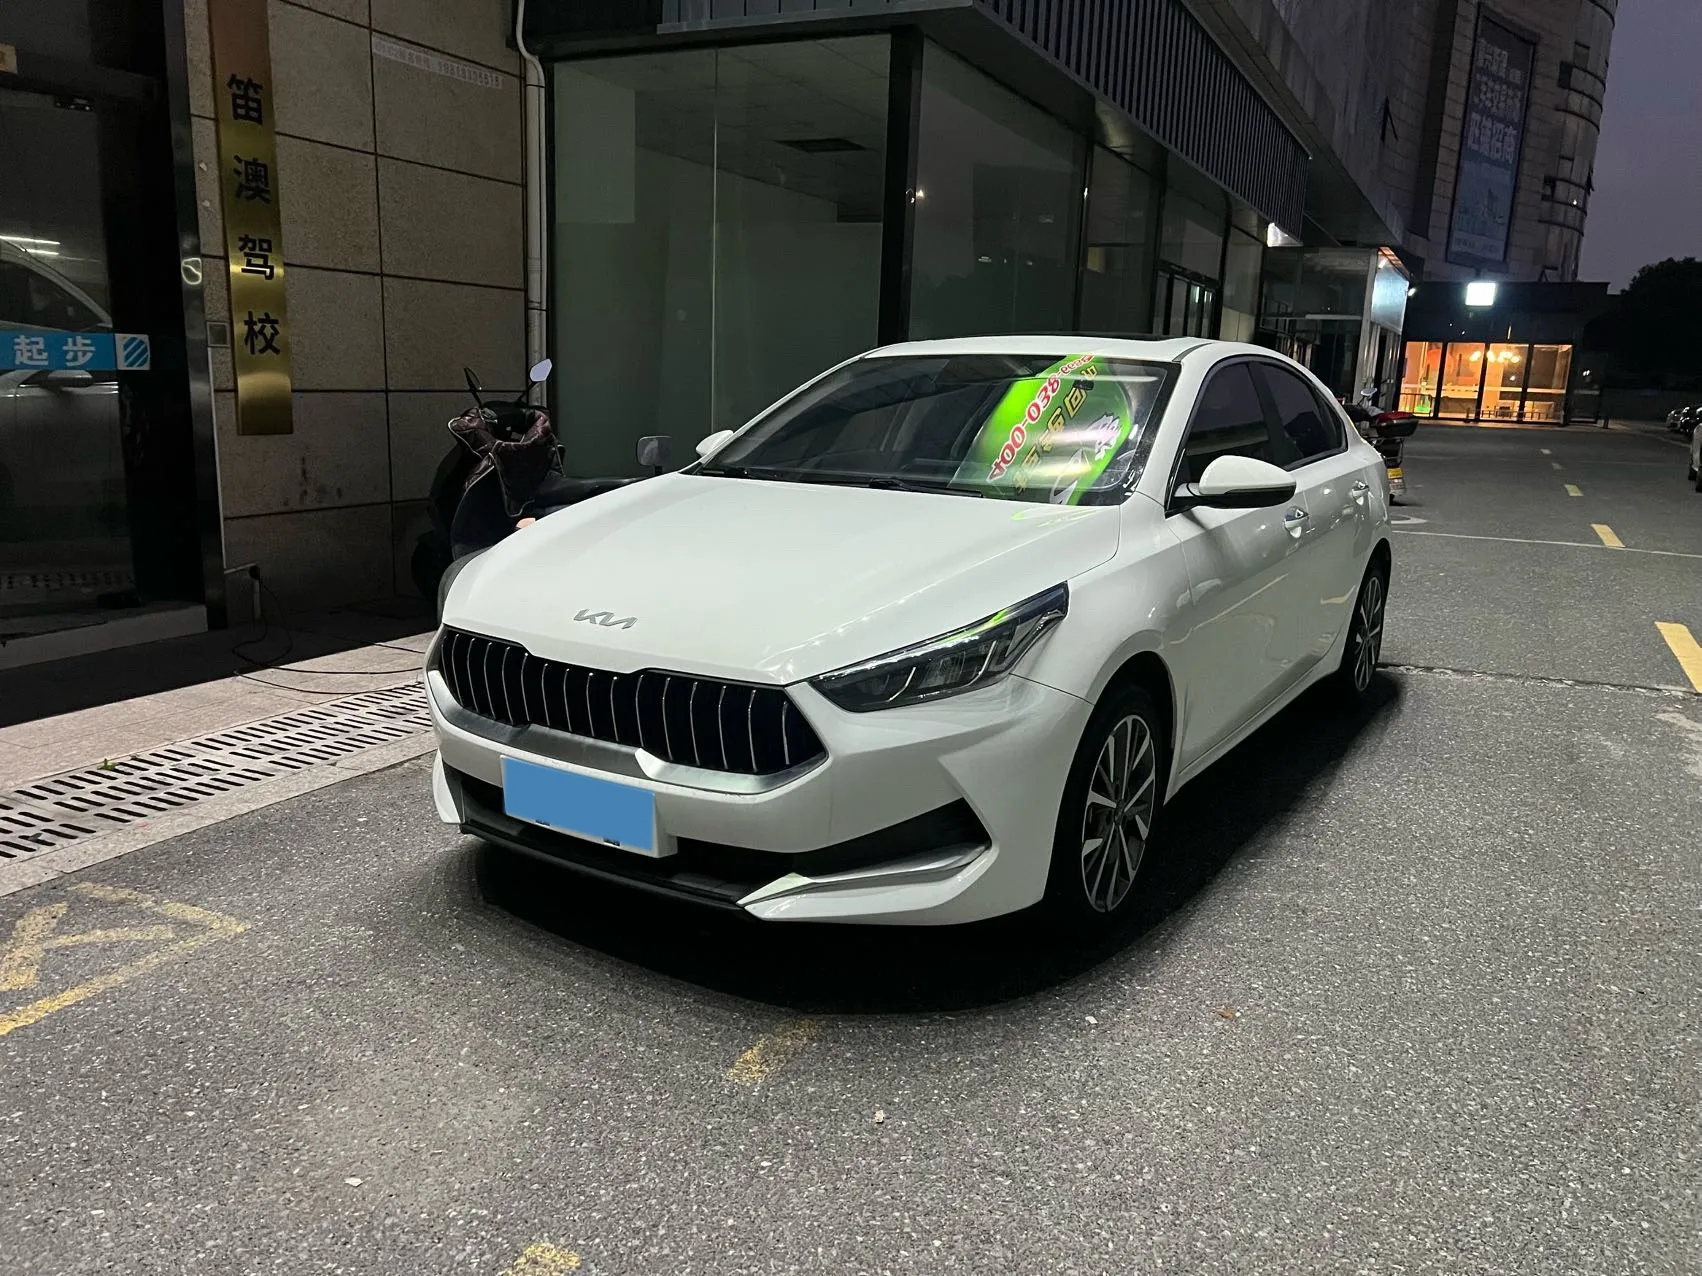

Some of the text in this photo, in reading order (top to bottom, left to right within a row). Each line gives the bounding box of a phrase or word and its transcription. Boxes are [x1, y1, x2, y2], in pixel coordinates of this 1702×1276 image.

[227, 74, 280, 355] 笛澳驾校
[13, 334, 96, 366] 起步
